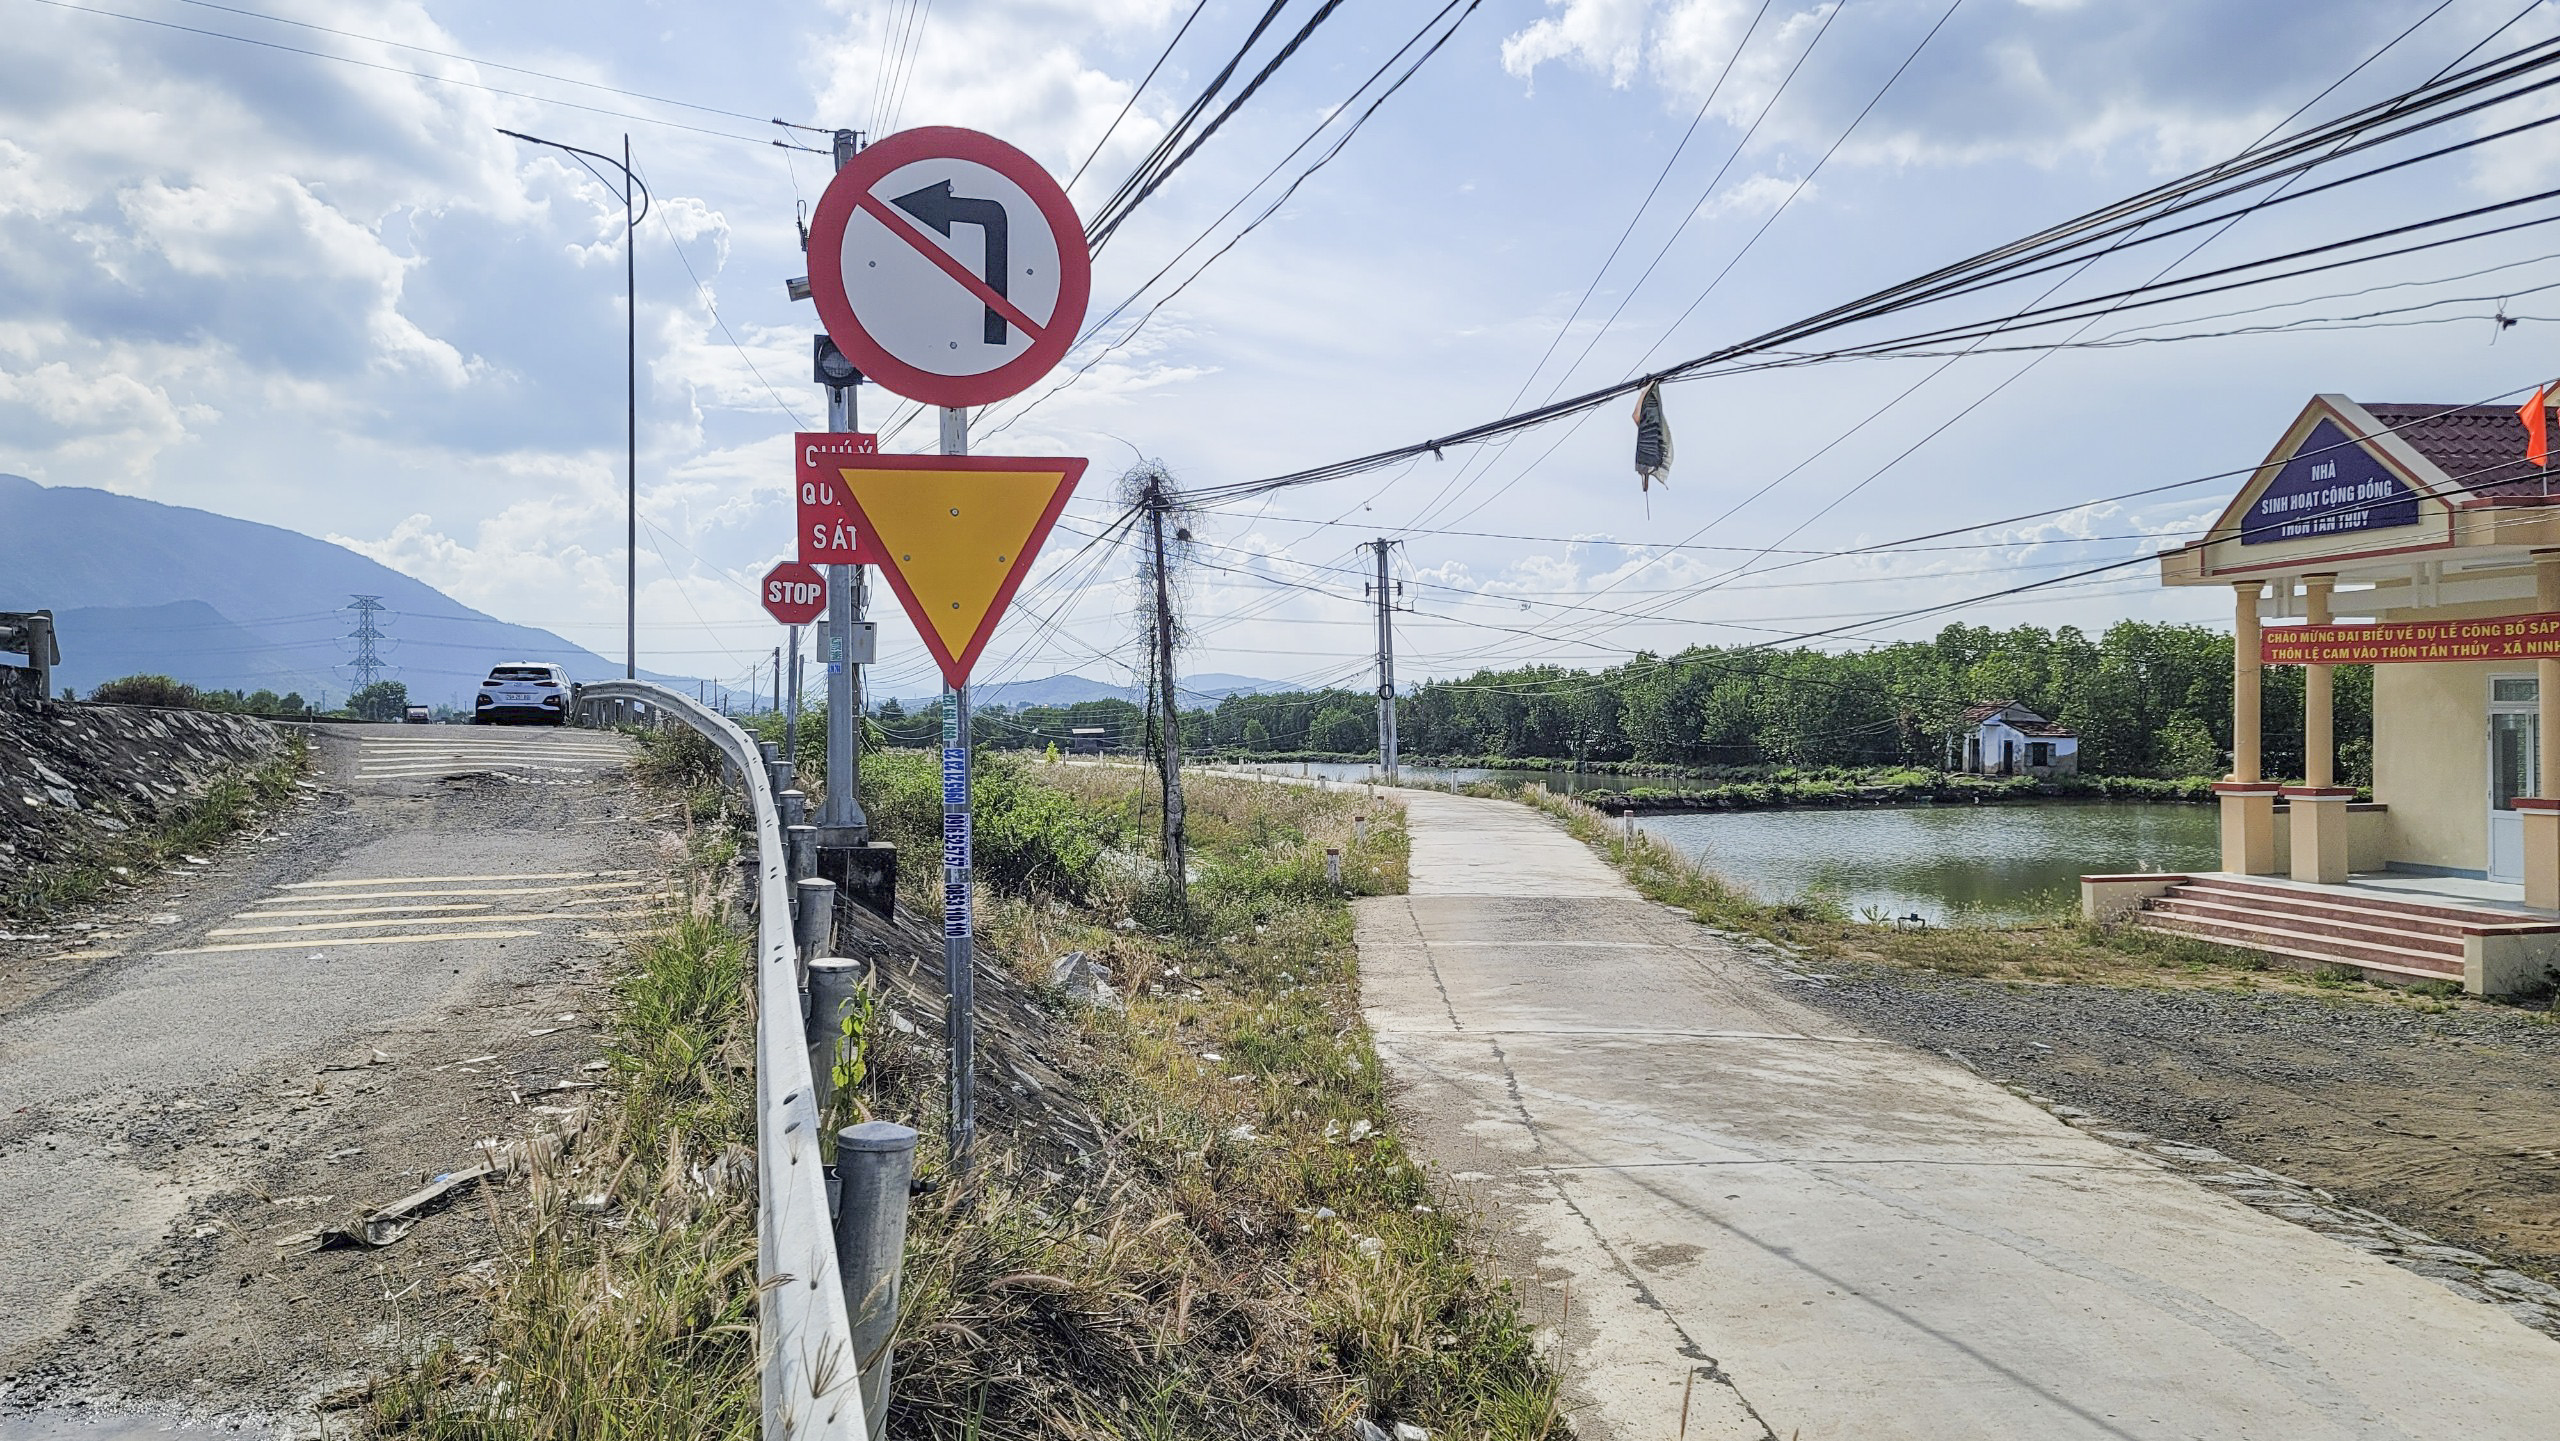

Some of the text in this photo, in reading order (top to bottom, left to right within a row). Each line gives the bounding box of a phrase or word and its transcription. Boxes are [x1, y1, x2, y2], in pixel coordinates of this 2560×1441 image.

[2261, 496, 2289, 514] SINH
[2290, 491, 2320, 511] HOẠT
[2321, 485, 2355, 507] CỘNG
[813, 518, 857, 551] SÁT
[768, 580, 821, 605] STOP
[2267, 630, 2297, 643] CHÀO
[2300, 629, 2334, 642] MỪNG
[2338, 630, 2359, 643] ĐẠI
[2362, 625, 2393, 641] BIỂU
[2418, 626, 2437, 641] DỰ
[2462, 623, 2501, 638] CÔNG
[2505, 619, 2526, 636] BỐ
[2529, 619, 2560, 634] SÁP
[2271, 646, 2302, 660] THÔN
[2305, 646, 2319, 661] LỆ
[2322, 647, 2350, 659] CAM
[2353, 645, 2378, 659] VÀO
[2381, 644, 2417, 659] THÔN
[2420, 643, 2448, 657] TÂN
[2452, 640, 2490, 656] THỦY
[2503, 639, 2523, 654] XÃ
